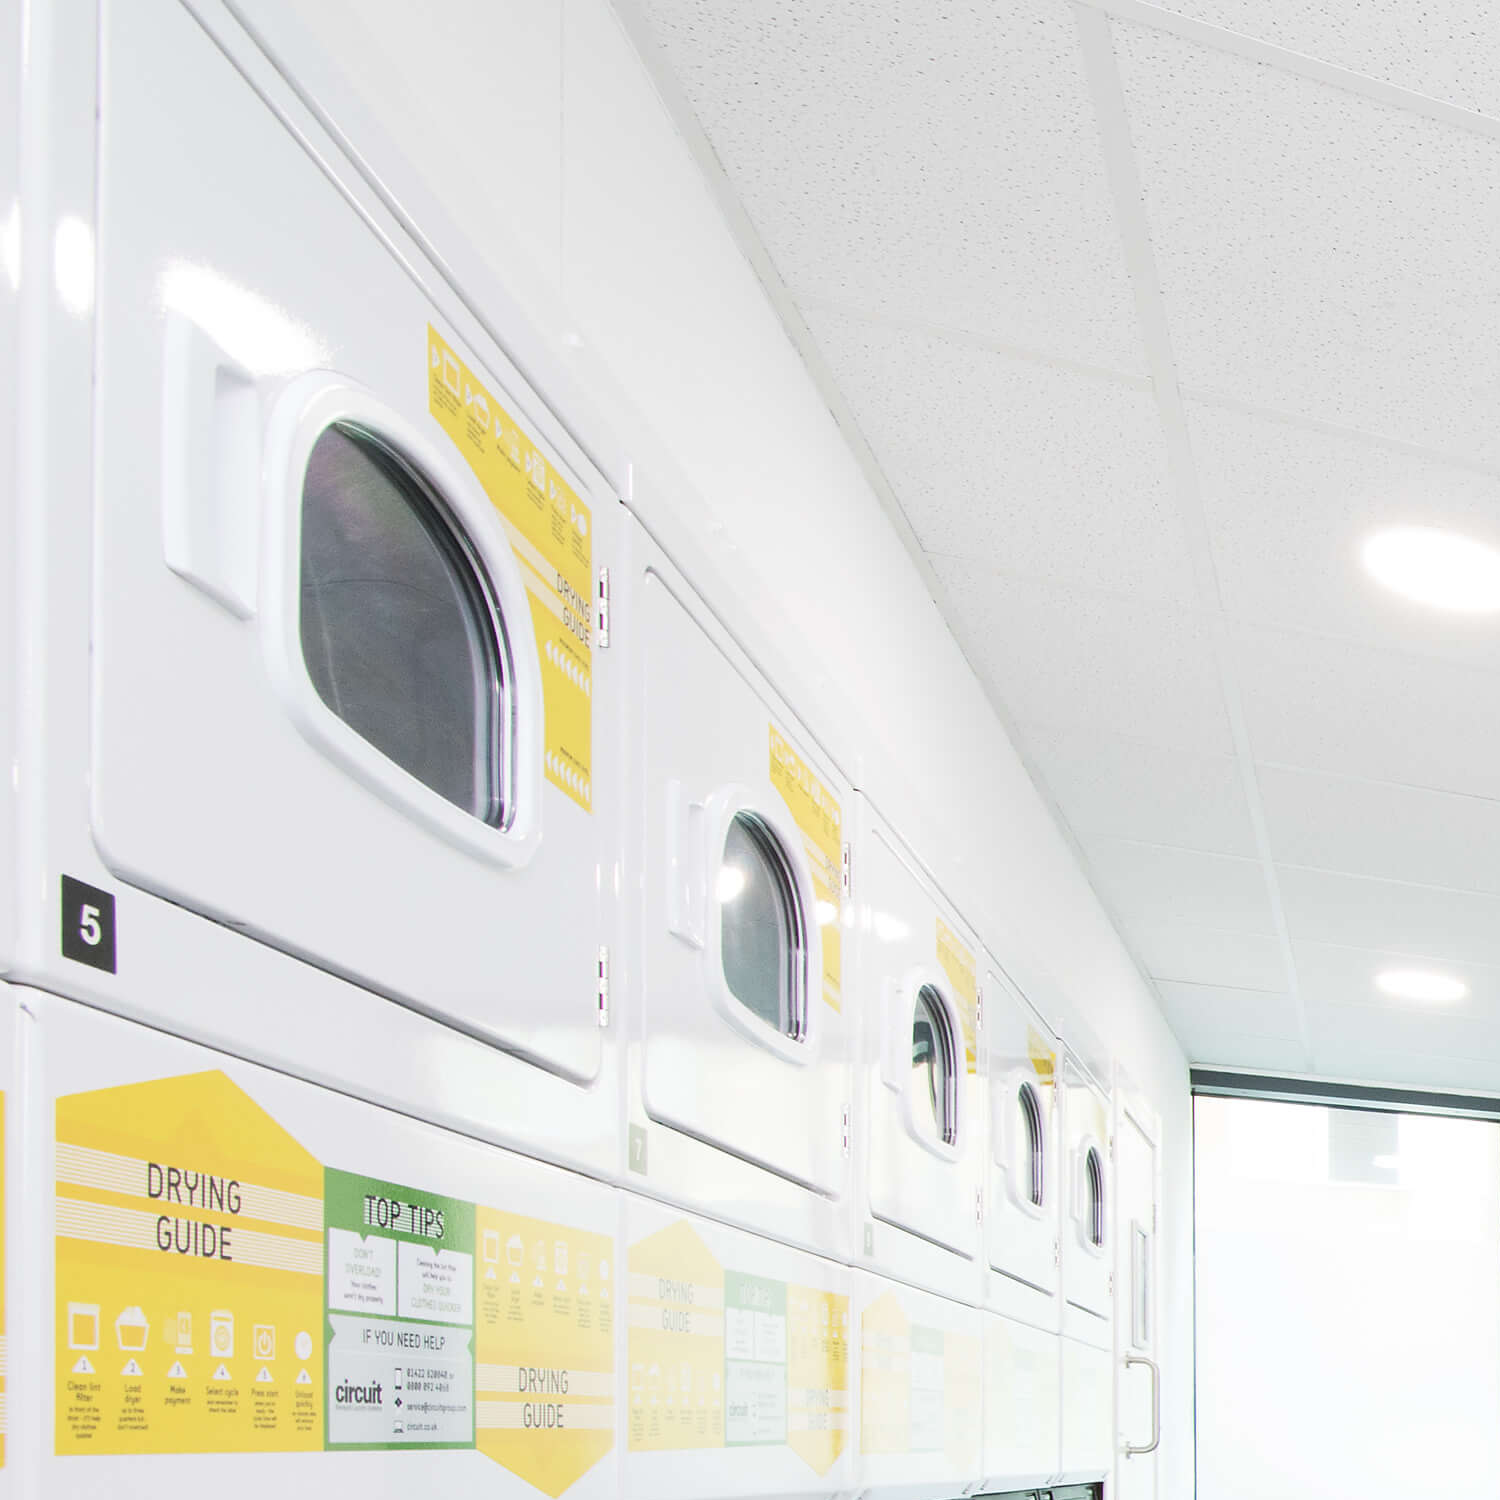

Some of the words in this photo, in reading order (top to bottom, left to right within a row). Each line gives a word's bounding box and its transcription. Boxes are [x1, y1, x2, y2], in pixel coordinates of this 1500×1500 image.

[556, 573, 591, 623] DRYING
[563, 607, 591, 648] GUIDE
[80, 903, 102, 945] 5
[634, 1137, 642, 1161] 7
[148, 1162, 241, 1214] DRYING
[365, 1195, 401, 1228] TOP
[408, 1204, 444, 1239] TIPS
[157, 1215, 232, 1260] GUIDE
[658, 1278, 695, 1305] DRYING
[662, 1308, 691, 1333] GUIDE
[362, 1329, 371, 1344] IF
[375, 1330, 394, 1346] YOU
[397, 1331, 420, 1349] NEED
[424, 1335, 445, 1351] HELP
[335, 1378, 383, 1405] circuit
[519, 1367, 569, 1395] DRYING
[523, 1403, 564, 1428] GUIDE
